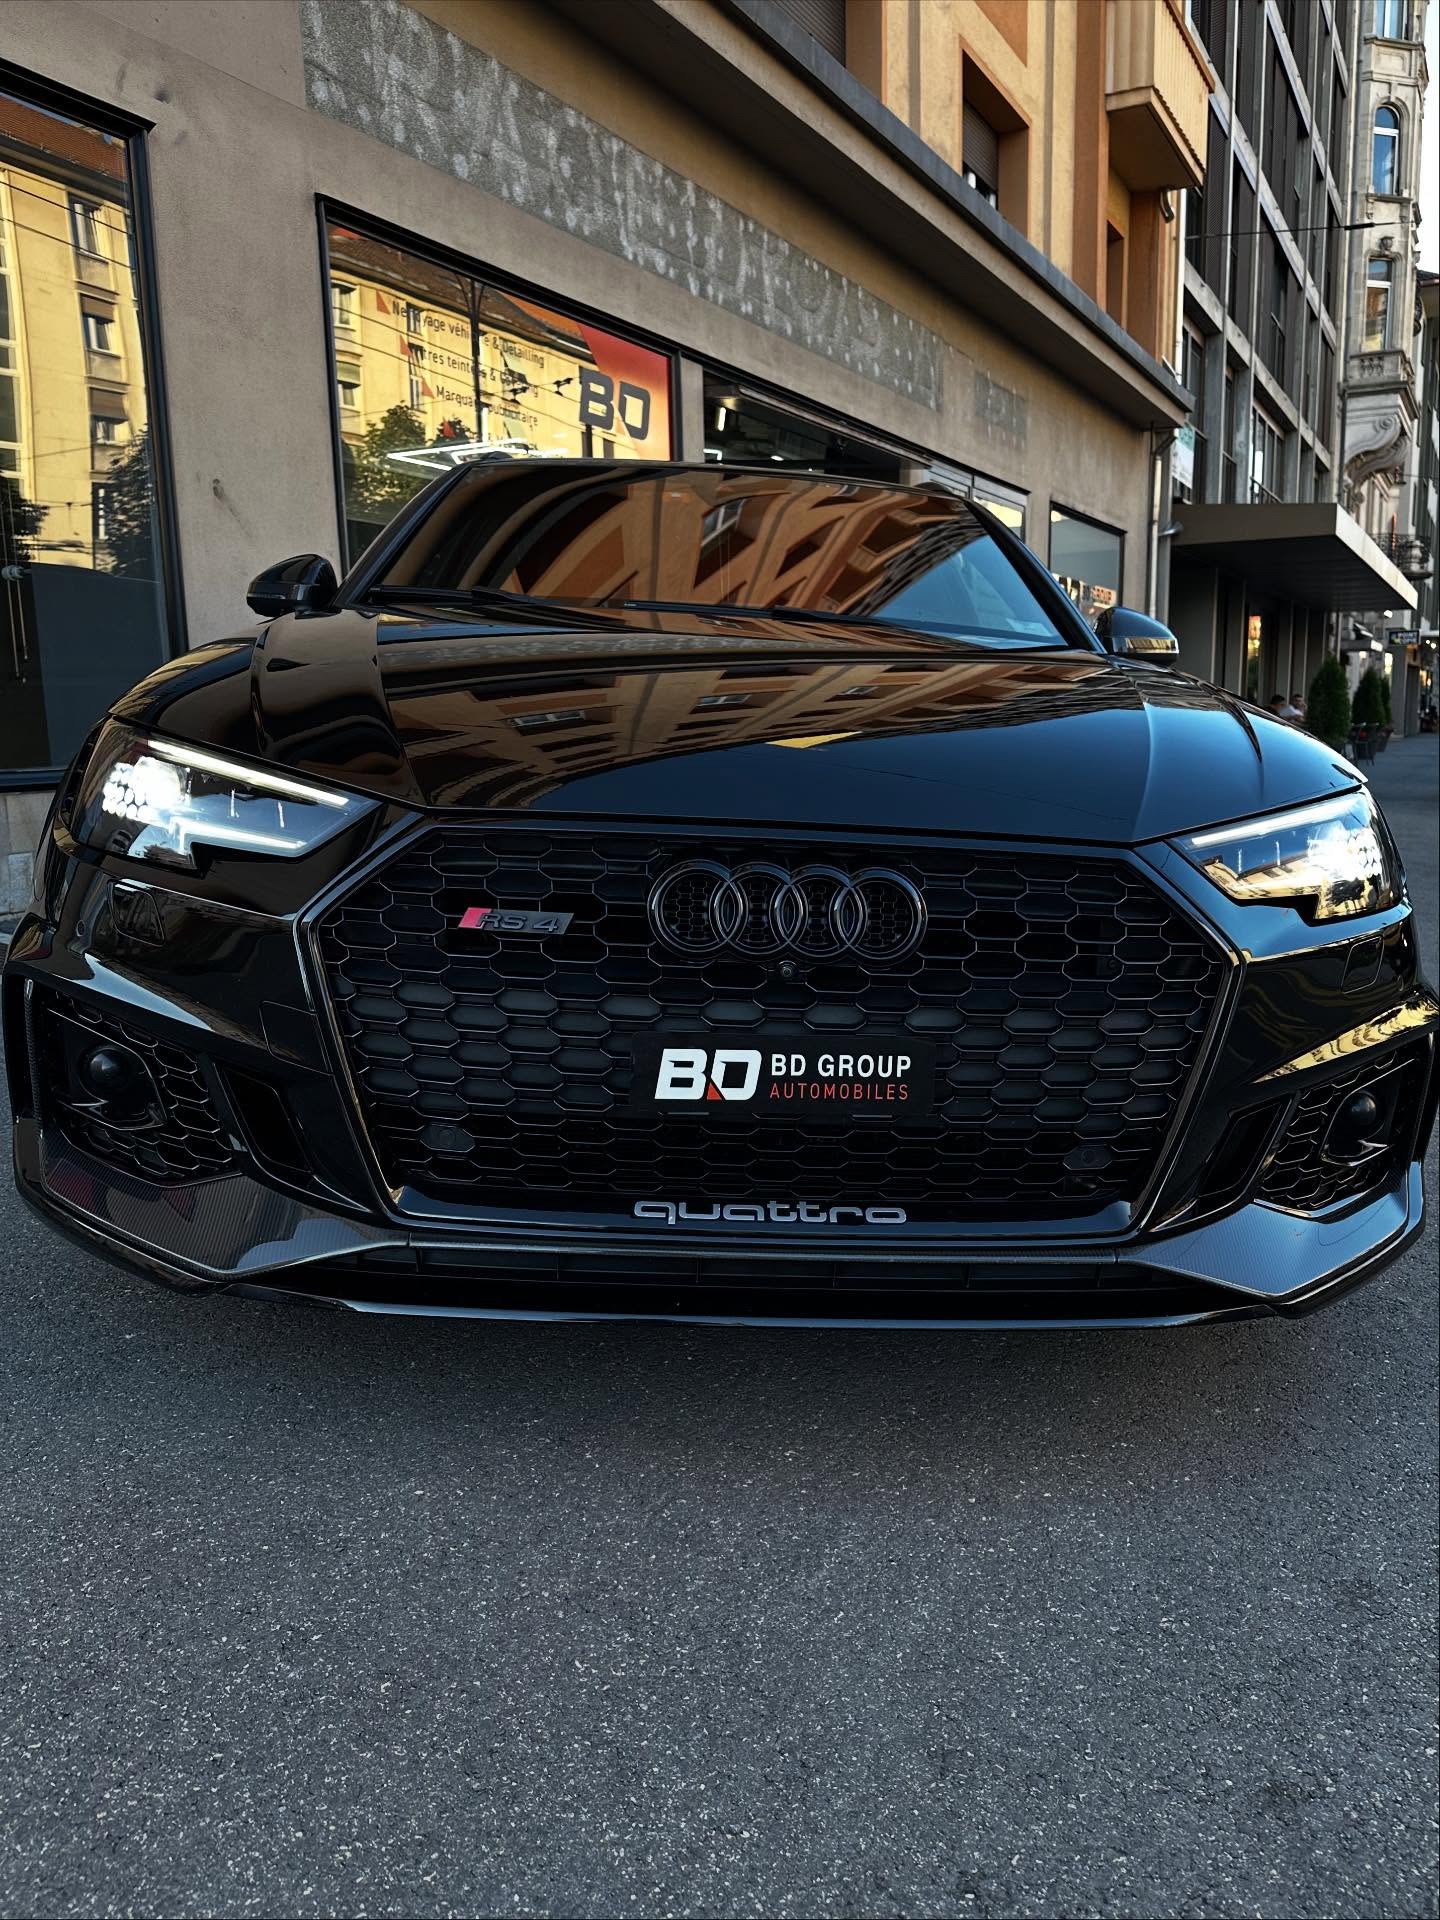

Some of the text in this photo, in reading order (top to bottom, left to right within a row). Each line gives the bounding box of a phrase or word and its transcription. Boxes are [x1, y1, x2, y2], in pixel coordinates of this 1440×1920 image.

[392, 301, 446, 332] Neyage
[449, 321, 489, 347] véhie
[436, 384, 477, 408] Marqua
[579, 366, 651, 440] BD
[654, 1048, 763, 1101] BD
[771, 1053, 913, 1078] BD GROUP
[769, 1082, 909, 1101] AUTOMOBILES
[633, 1200, 907, 1226] quattro
